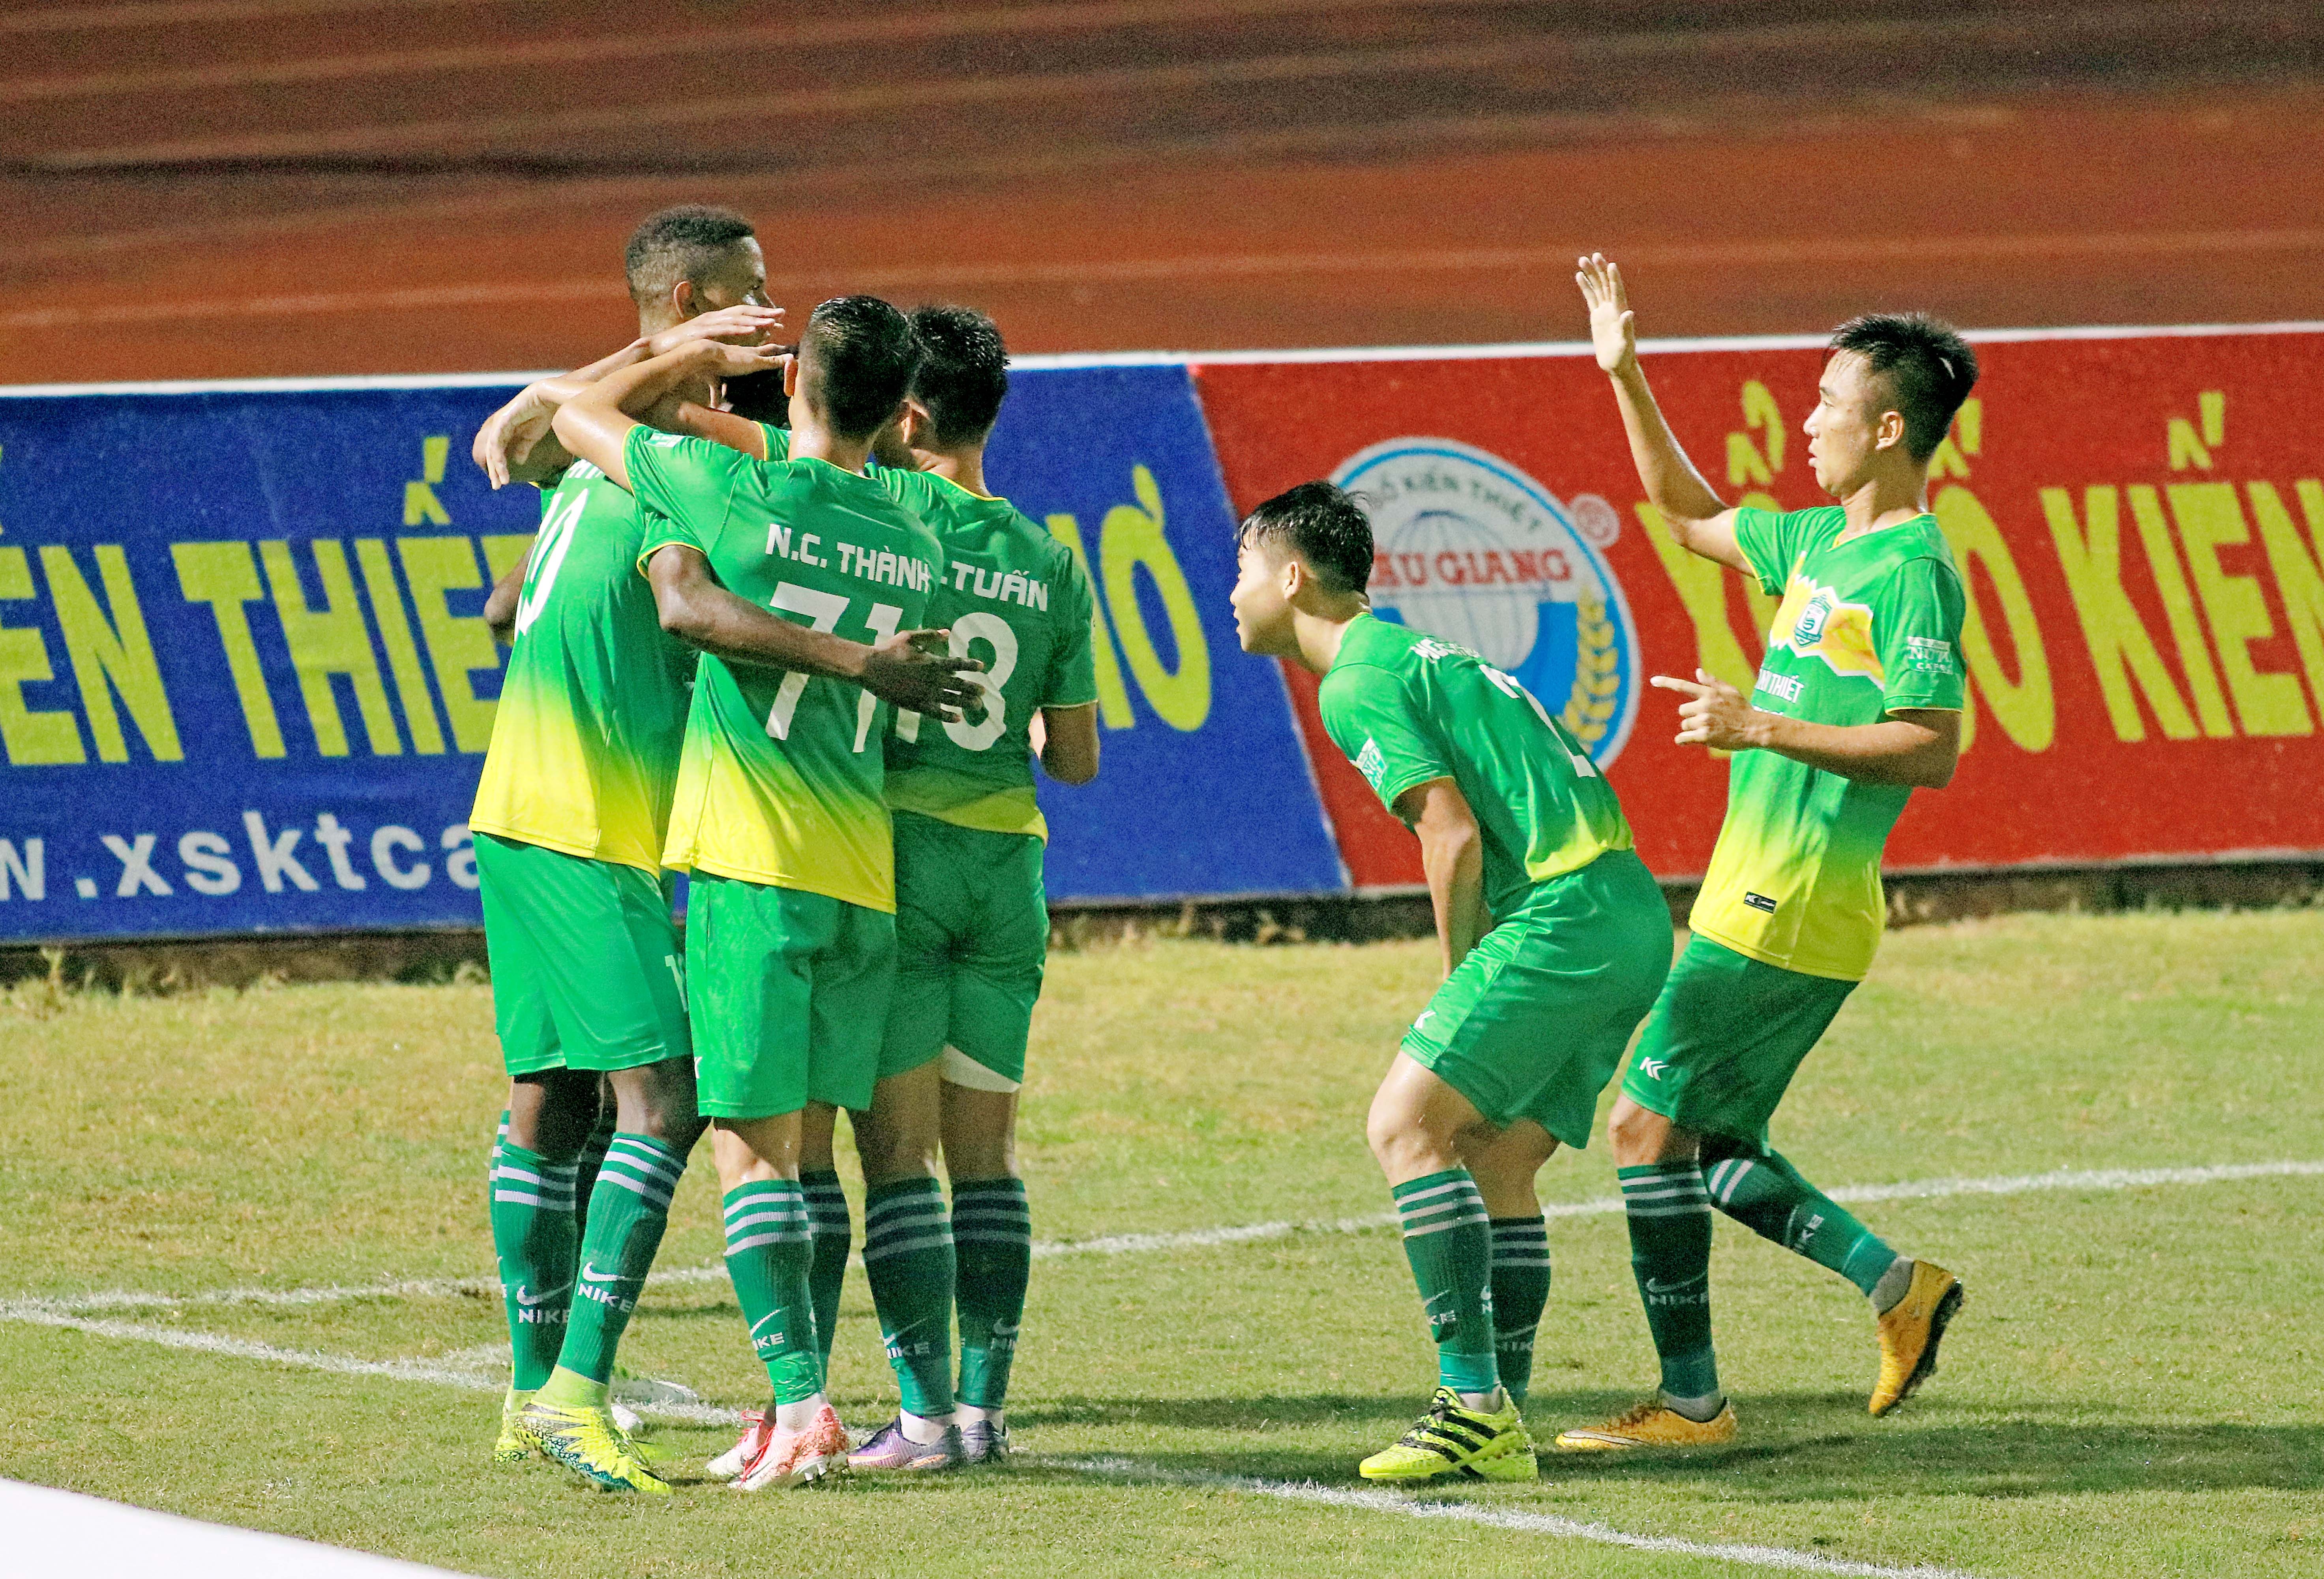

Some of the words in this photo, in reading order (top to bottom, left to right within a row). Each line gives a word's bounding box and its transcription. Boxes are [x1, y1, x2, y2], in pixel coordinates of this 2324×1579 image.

[765, 523, 828, 568] N.C.
[836, 541, 929, 593] THÀNH
[1434, 548, 1573, 586] GIANG
[1767, 674, 1805, 704] THIẾT
[577, 1283, 633, 1313] NIKE
